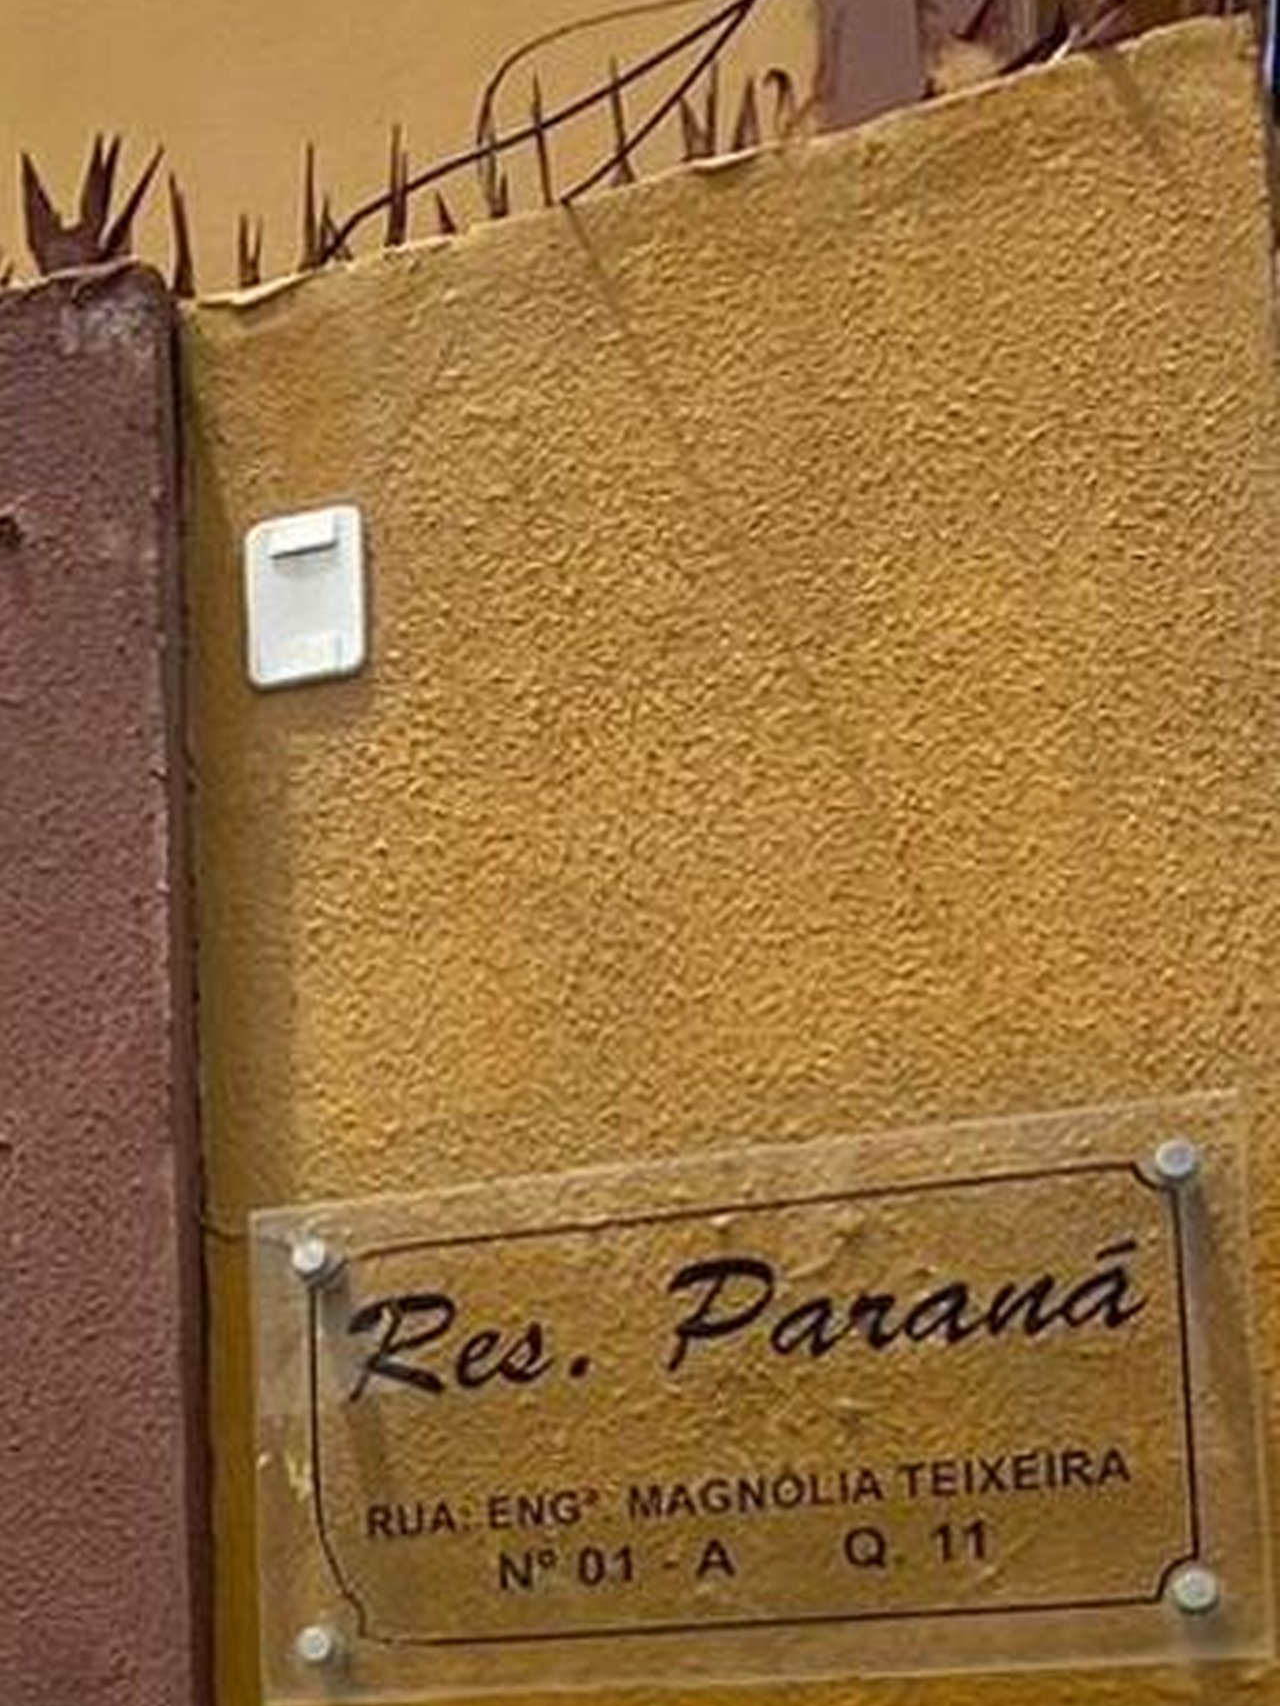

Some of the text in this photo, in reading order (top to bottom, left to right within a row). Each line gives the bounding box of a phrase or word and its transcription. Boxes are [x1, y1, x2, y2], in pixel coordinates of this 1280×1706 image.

[346, 1239, 1148, 1403] Res. Paraná
[897, 1448, 1131, 1500] TEIXEIRA
[577, 1545, 633, 1586] 01
[696, 1539, 736, 1578] A
[931, 1519, 986, 1563] 11
